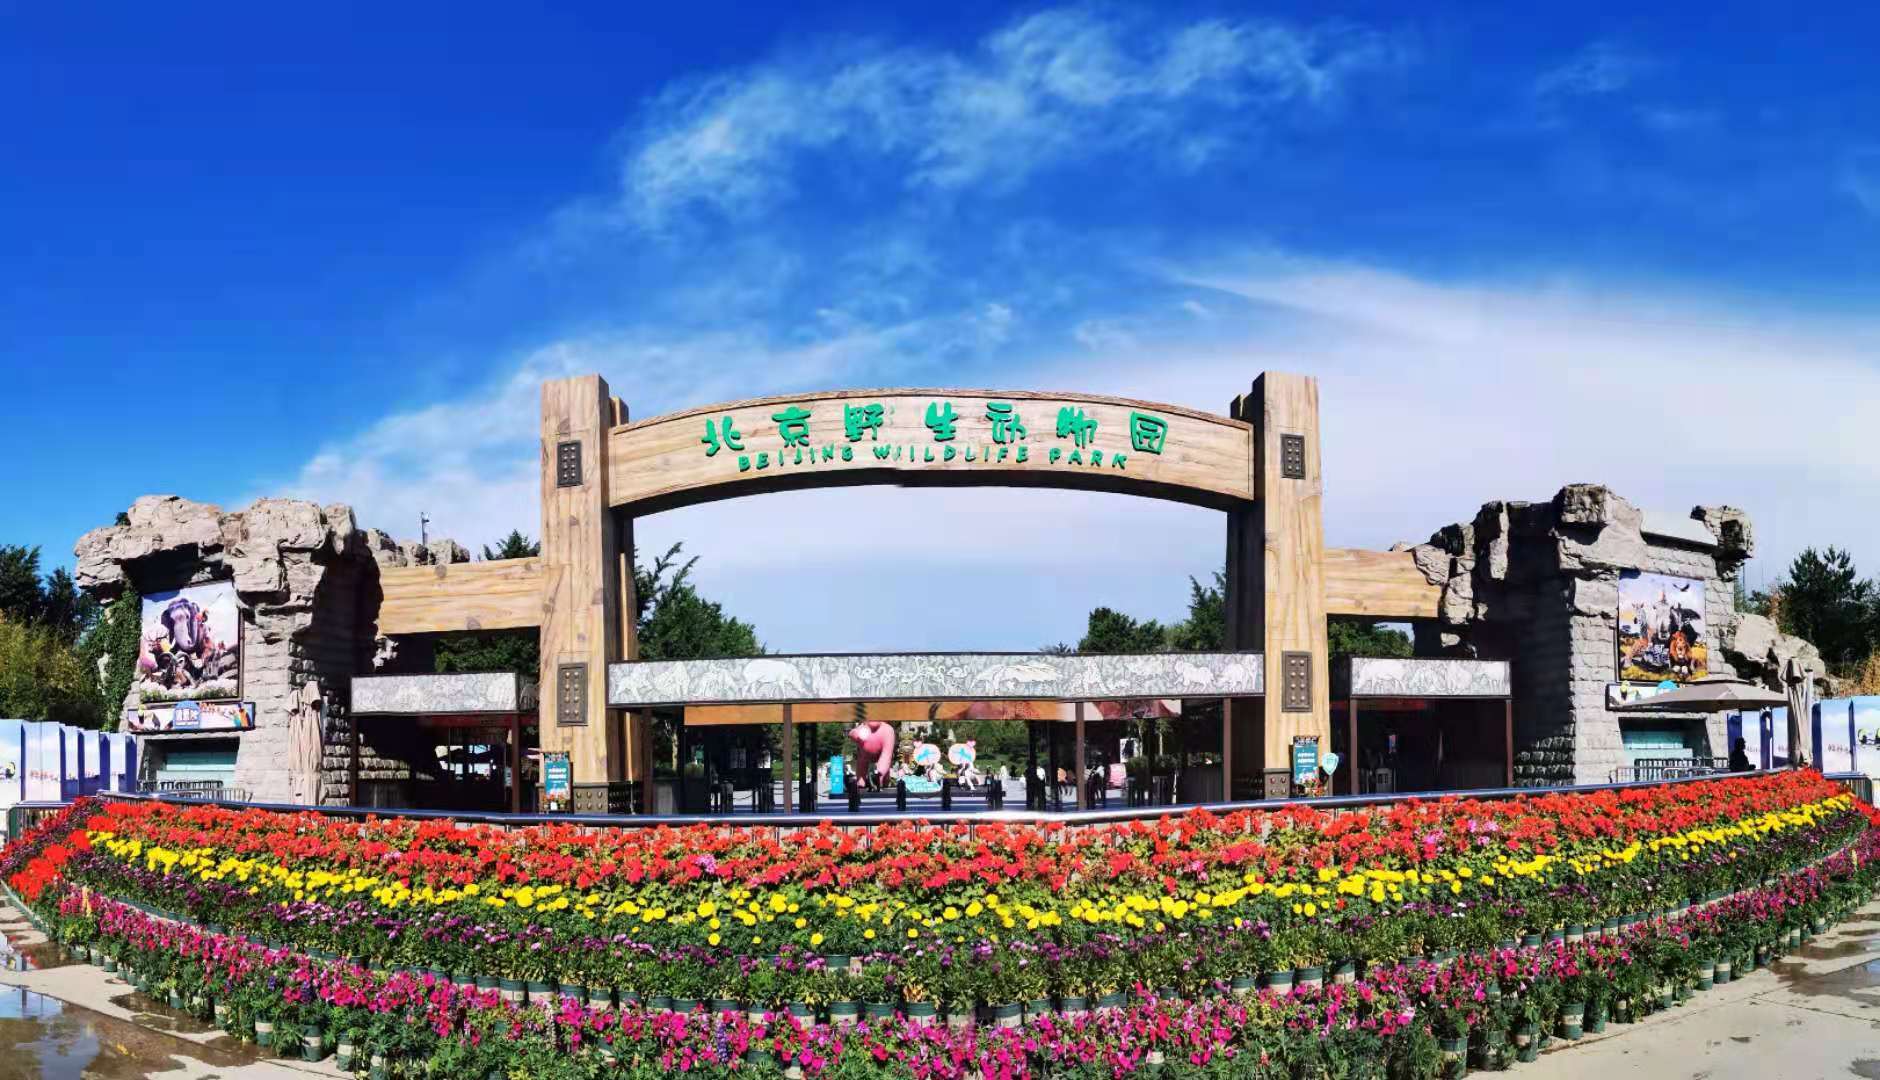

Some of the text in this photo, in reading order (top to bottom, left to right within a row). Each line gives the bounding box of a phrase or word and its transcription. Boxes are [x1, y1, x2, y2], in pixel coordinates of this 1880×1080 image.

[701, 401, 1168, 457] 北京野生动物园
[737, 443, 854, 472] BEIJING
[1050, 447, 1128, 470] PARK
